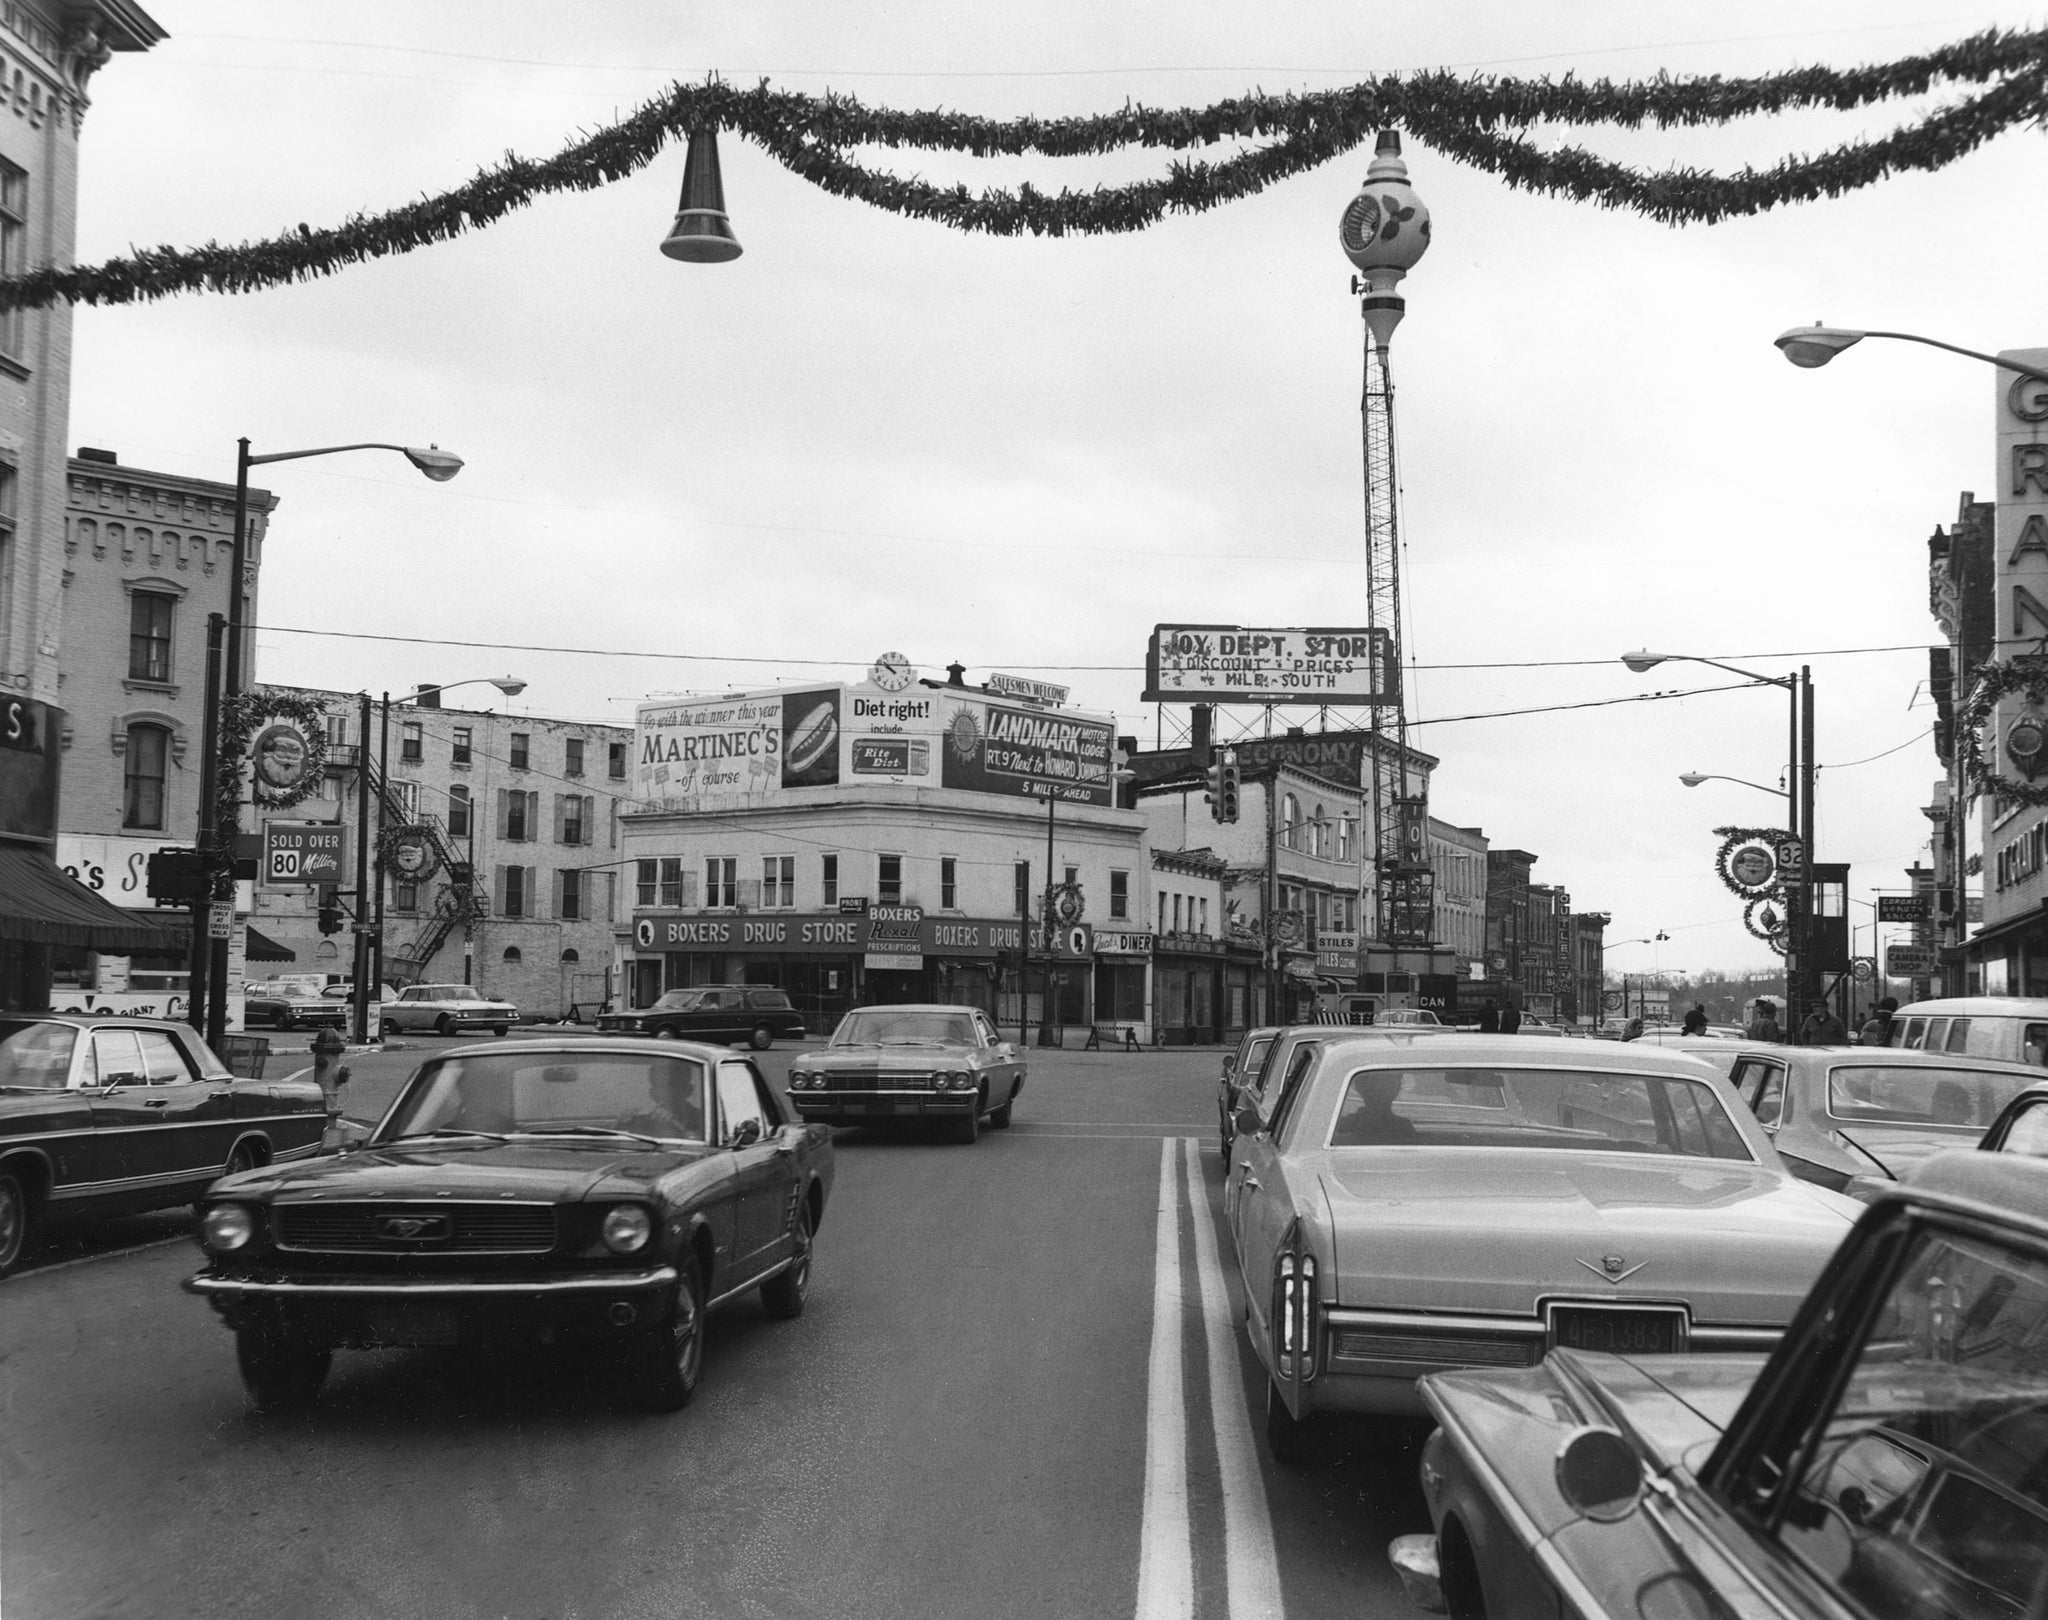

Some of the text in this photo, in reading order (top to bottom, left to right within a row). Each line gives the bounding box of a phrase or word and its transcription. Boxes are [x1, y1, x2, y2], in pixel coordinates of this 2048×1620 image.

[1220, 634, 1293, 658] DEPT.
[1305, 636, 1385, 658] STORE
[1186, 657, 1354, 674] DISCOUNT PRICES
[991, 674, 1067, 702] SALESMEN WELCOME
[1281, 674, 1336, 687] SOUTH
[657, 711, 679, 729] with
[680, 708, 694, 726] the
[738, 703, 757, 721] this
[757, 704, 781, 726] year
[854, 699, 930, 722] Diet right!
[871, 723, 903, 734] include
[988, 713, 1081, 755] LANDMARK
[1081, 728, 1108, 743] MOTOR
[641, 721, 780, 765] MARTINEC'S
[1080, 743, 1106, 758] LODGE
[1002, 751, 1009, 766] 9
[1010, 752, 1033, 772] Next
[1033, 757, 1044, 773] to
[1044, 752, 1076, 778] HOWARD
[702, 770, 741, 787] course
[1022, 781, 1092, 801] 5 MILES AHEAD
[271, 834, 339, 848] SOLD OVER
[273, 852, 338, 876] 80 Million
[1780, 847, 1802, 864] 32
[841, 898, 863, 907] PHONE
[869, 907, 921, 921] BOXERS
[668, 922, 730, 944] BOXERS
[744, 922, 787, 944] DRUG
[802, 922, 858, 944] STORE
[935, 924, 979, 947] BOXERS
[989, 926, 1020, 949] DRUG
[867, 942, 921, 952] PRESCRIPTIONS
[1121, 935, 1151, 951] DINER
[1894, 962, 1922, 971] SHOP
[1420, 996, 1446, 1008] CAN
